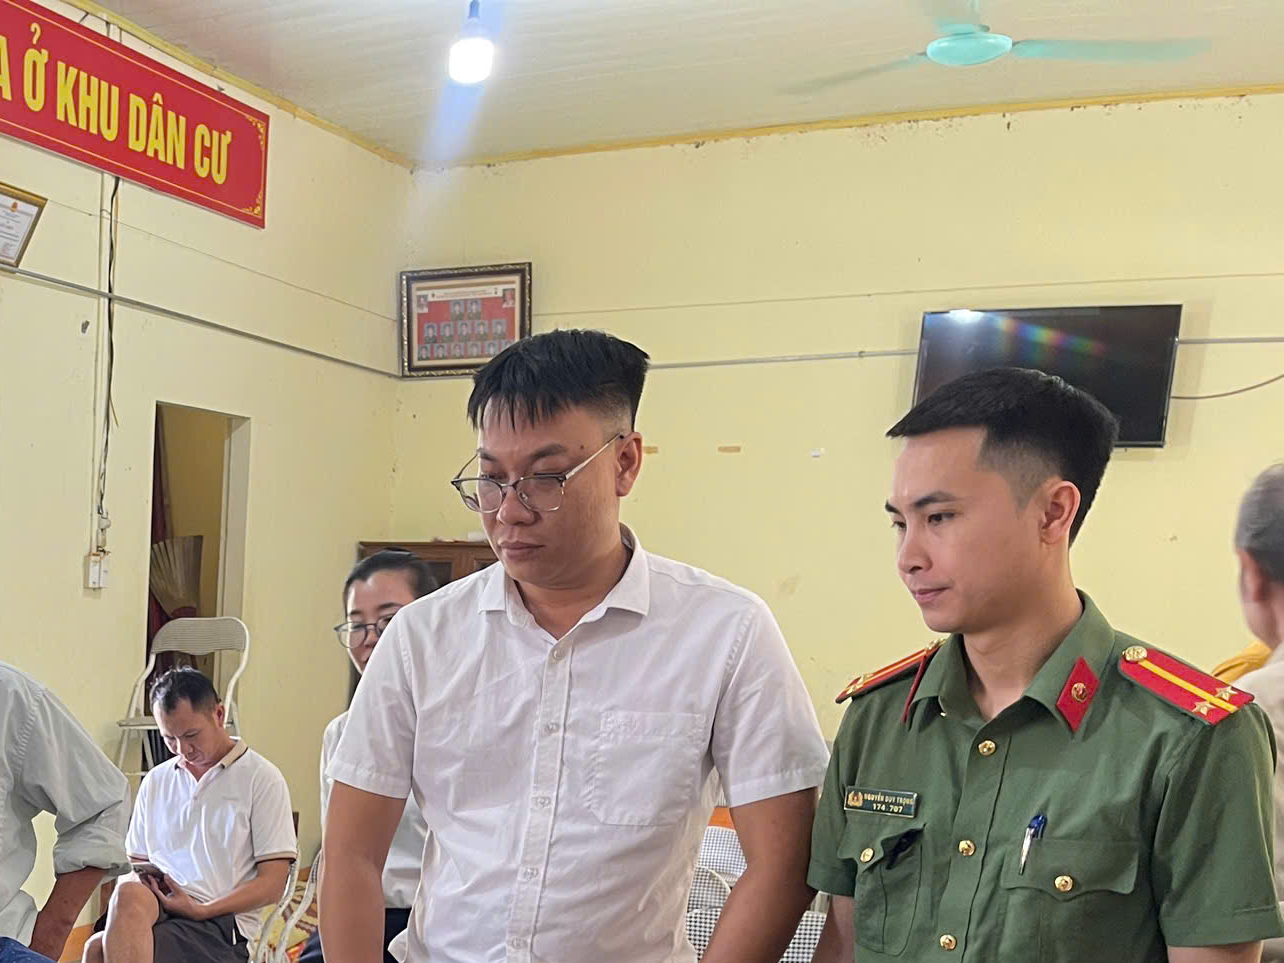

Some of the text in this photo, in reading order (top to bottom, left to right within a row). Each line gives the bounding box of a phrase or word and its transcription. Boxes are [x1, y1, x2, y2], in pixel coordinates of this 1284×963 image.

[23, 22, 49, 112] Ở
[56, 60, 119, 142] KHU
[128, 92, 187, 170] DÂN
[194, 123, 232, 185] CƯ
